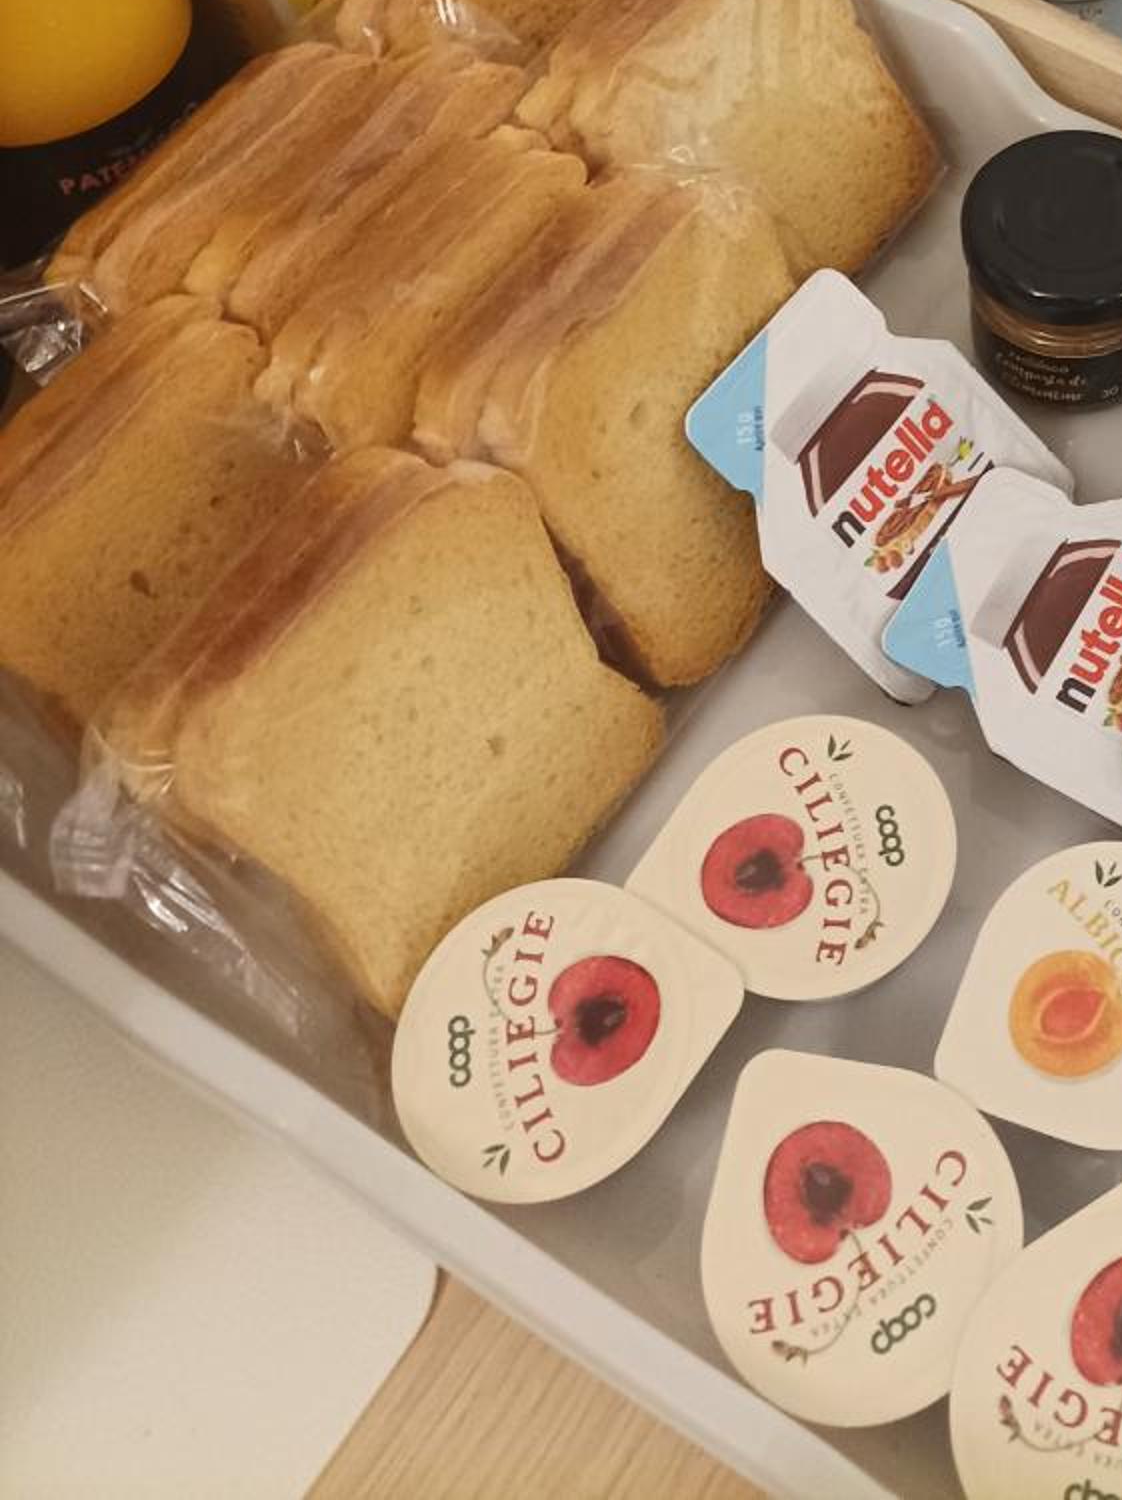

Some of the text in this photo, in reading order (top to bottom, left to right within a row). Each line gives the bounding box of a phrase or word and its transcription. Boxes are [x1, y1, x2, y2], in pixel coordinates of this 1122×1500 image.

[831, 400, 955, 548] nutella
[777, 746, 855, 966] CILIEGIE
[875, 804, 905, 866] coop
[448, 1016, 476, 1086] coop
[506, 910, 565, 1164] CILIEGIE
[747, 1149, 968, 1335] CILIEGIE
[867, 1216, 955, 1309] CONFETTURA
[871, 1293, 936, 1355] coop
